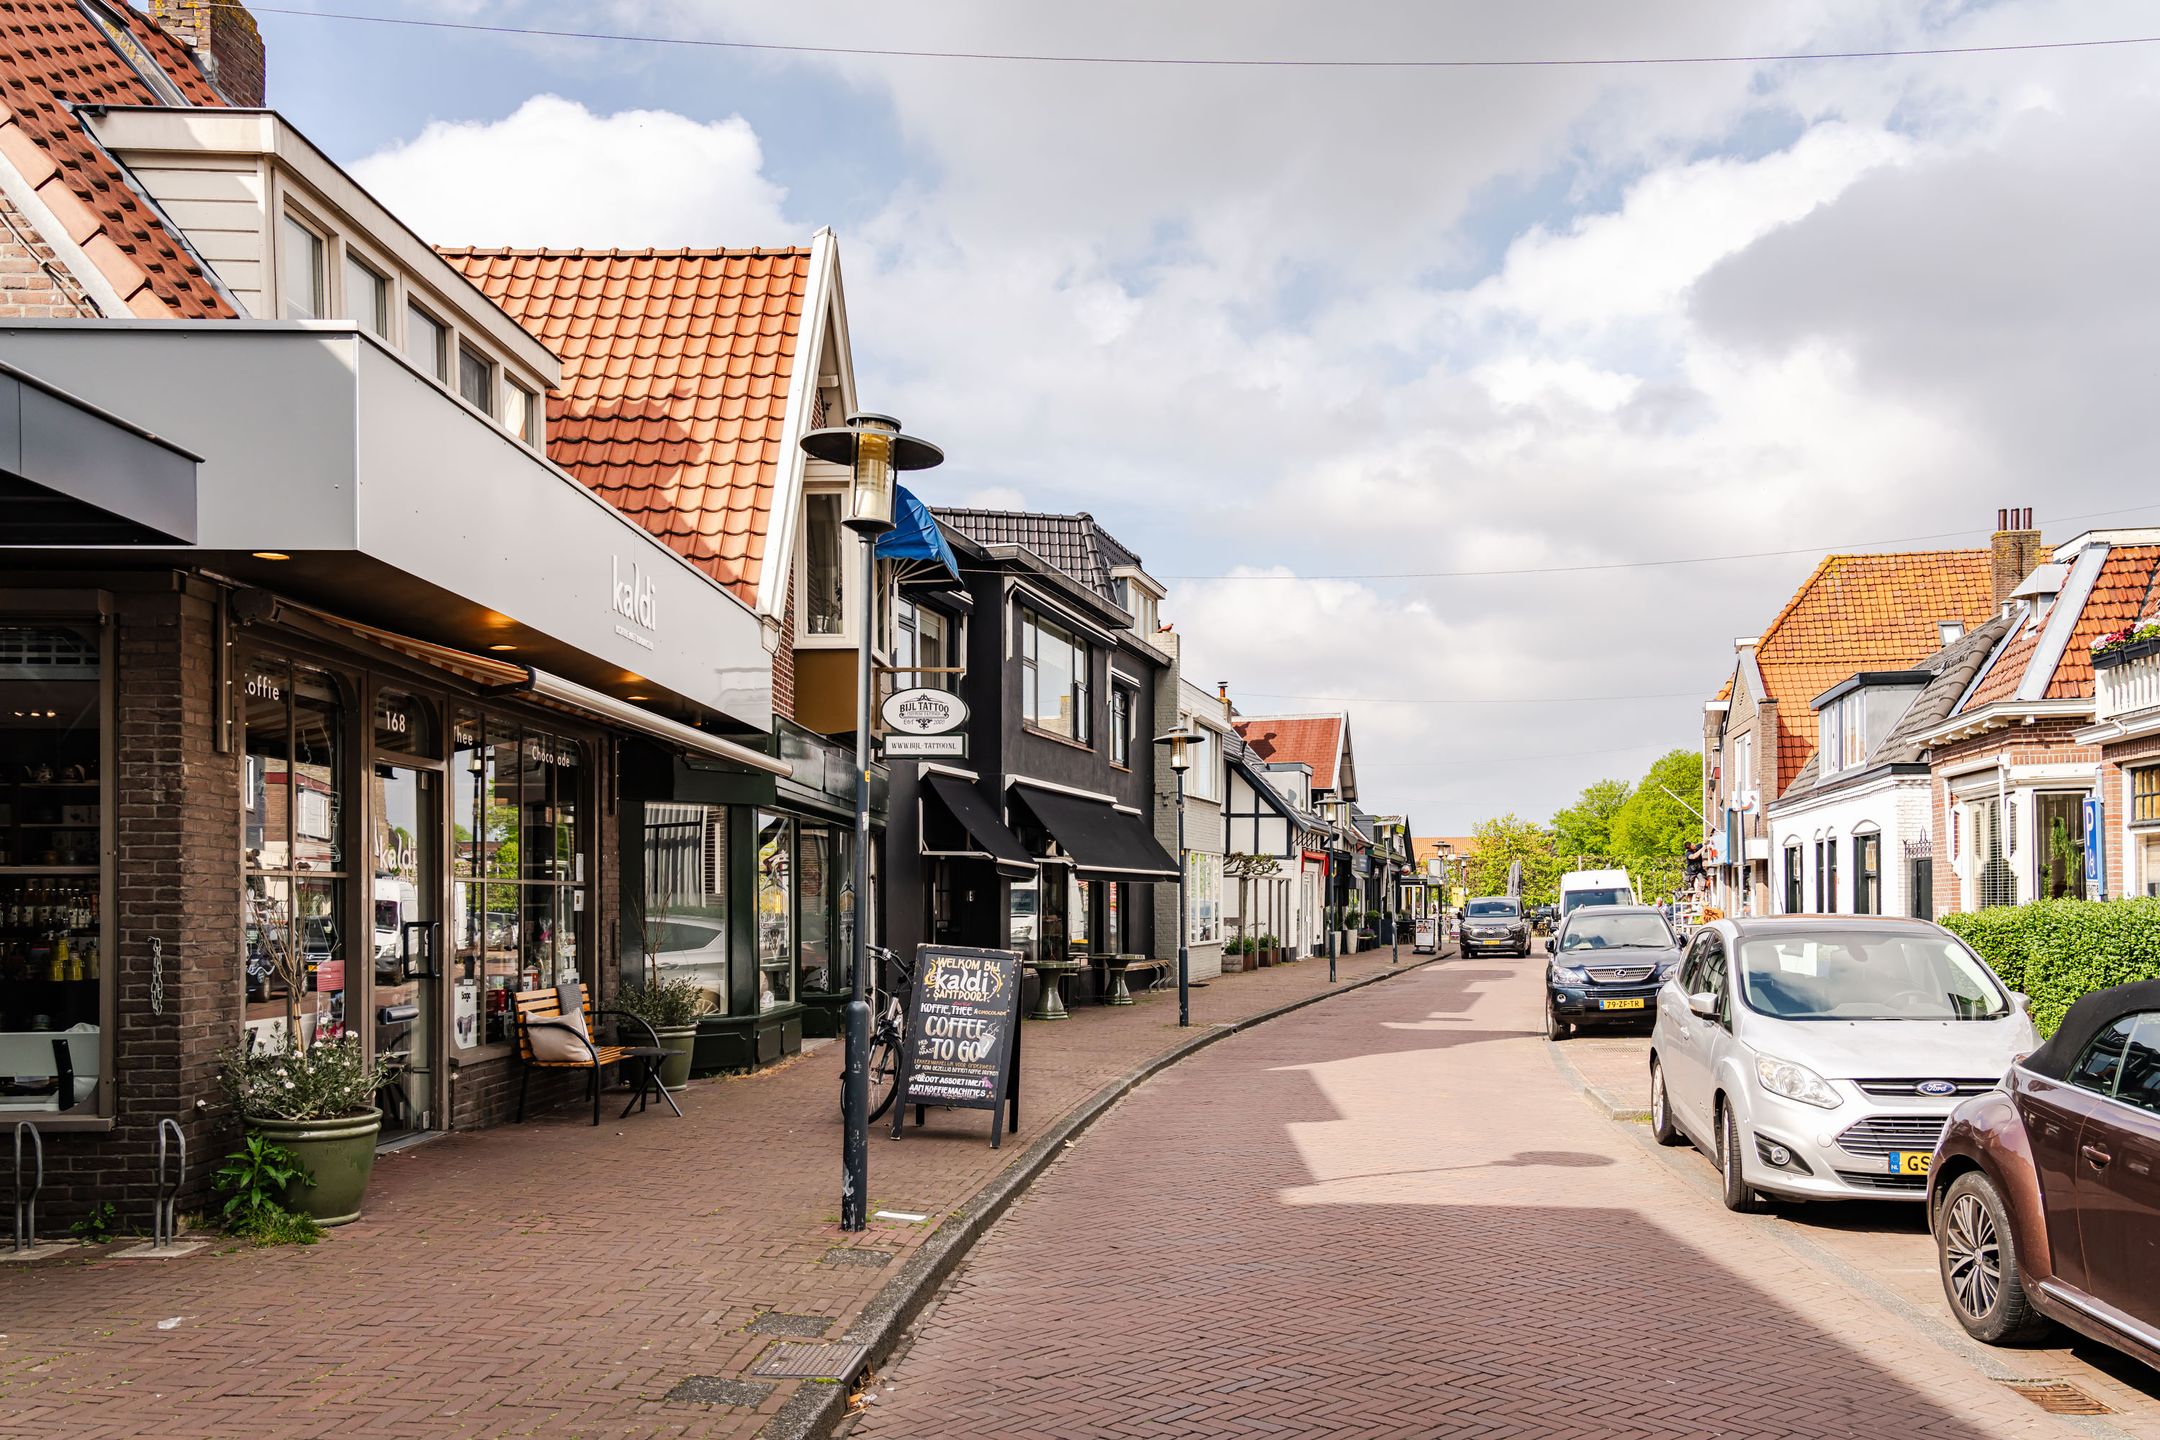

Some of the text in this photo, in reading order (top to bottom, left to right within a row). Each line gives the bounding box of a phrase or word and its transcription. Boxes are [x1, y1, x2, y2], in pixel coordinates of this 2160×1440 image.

[611, 555, 656, 631] kaldi
[899, 701, 949, 714] BIJL TATTOO
[386, 711, 406, 732] 168
[532, 746, 570, 767] Chocoade
[2085, 806, 2094, 846] P
[937, 957, 980, 970] WELKOM
[934, 964, 989, 993] kaldi
[951, 1005, 973, 1016] THEE
[925, 1015, 988, 1039] COFFEE
[931, 1037, 954, 1060] TO
[917, 1075, 939, 1083] GROOT
[1926, 1083, 1948, 1092] Ford
